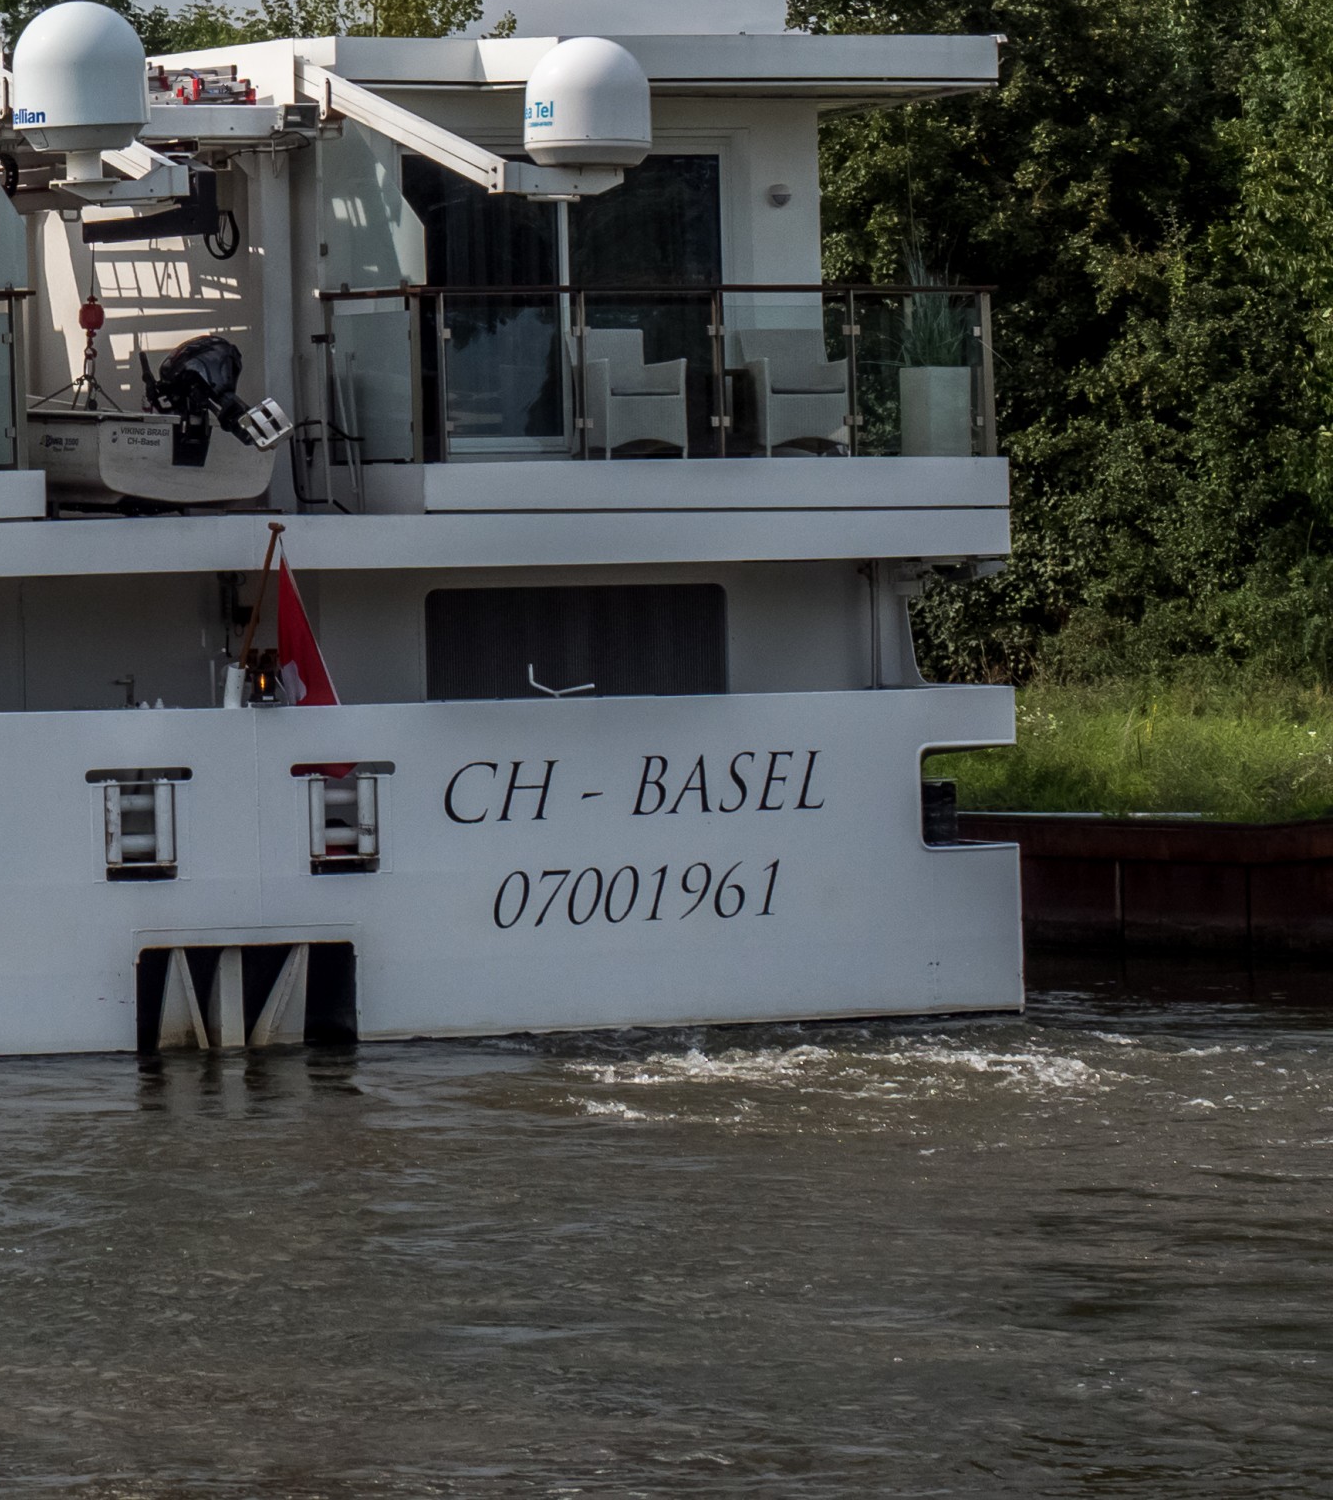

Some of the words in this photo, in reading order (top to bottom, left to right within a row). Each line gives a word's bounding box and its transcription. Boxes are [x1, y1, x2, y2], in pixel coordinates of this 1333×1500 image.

[535, 101, 553, 118] Tel
[120, 426, 146, 436] VIKING
[147, 428, 170, 437] BRAGI
[443, 759, 559, 824] CH
[631, 749, 826, 816] BASEL
[492, 858, 781, 929] 07001961
